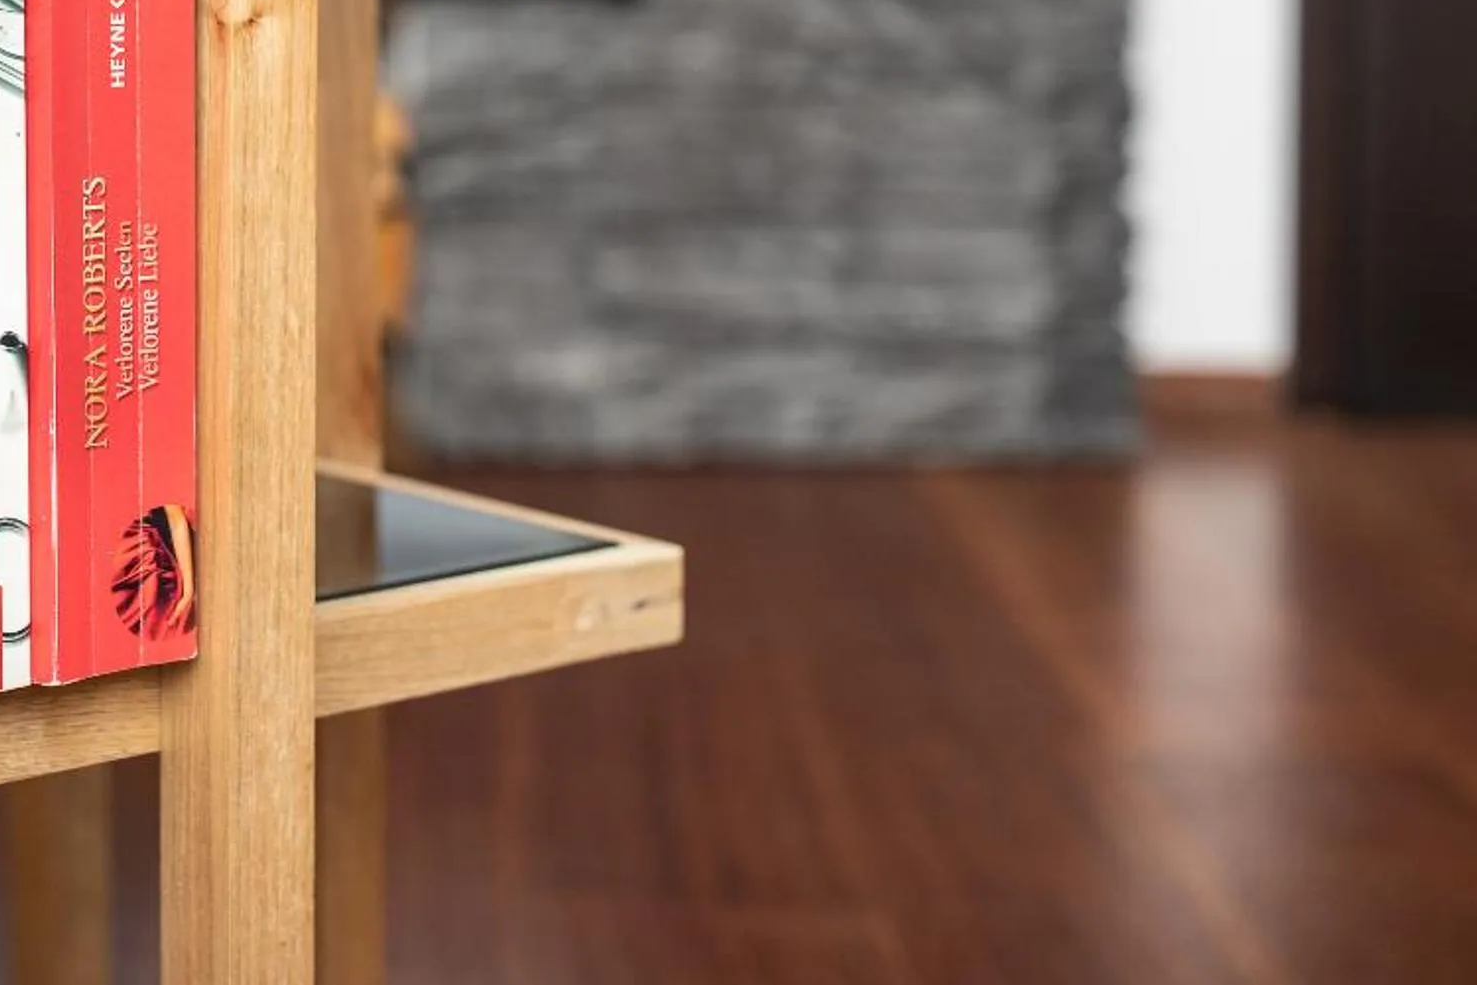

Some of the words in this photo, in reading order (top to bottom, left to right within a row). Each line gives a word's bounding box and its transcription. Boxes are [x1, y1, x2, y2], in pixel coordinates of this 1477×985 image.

[110, 12, 125, 88] HEYNE
[82, 176, 107, 336] ROBERTS
[114, 221, 134, 289] Seelen
[138, 223, 159, 284] Liebe
[115, 297, 134, 400] Verlorene
[138, 288, 159, 391] Verlorene
[83, 346, 108, 450] NORA
